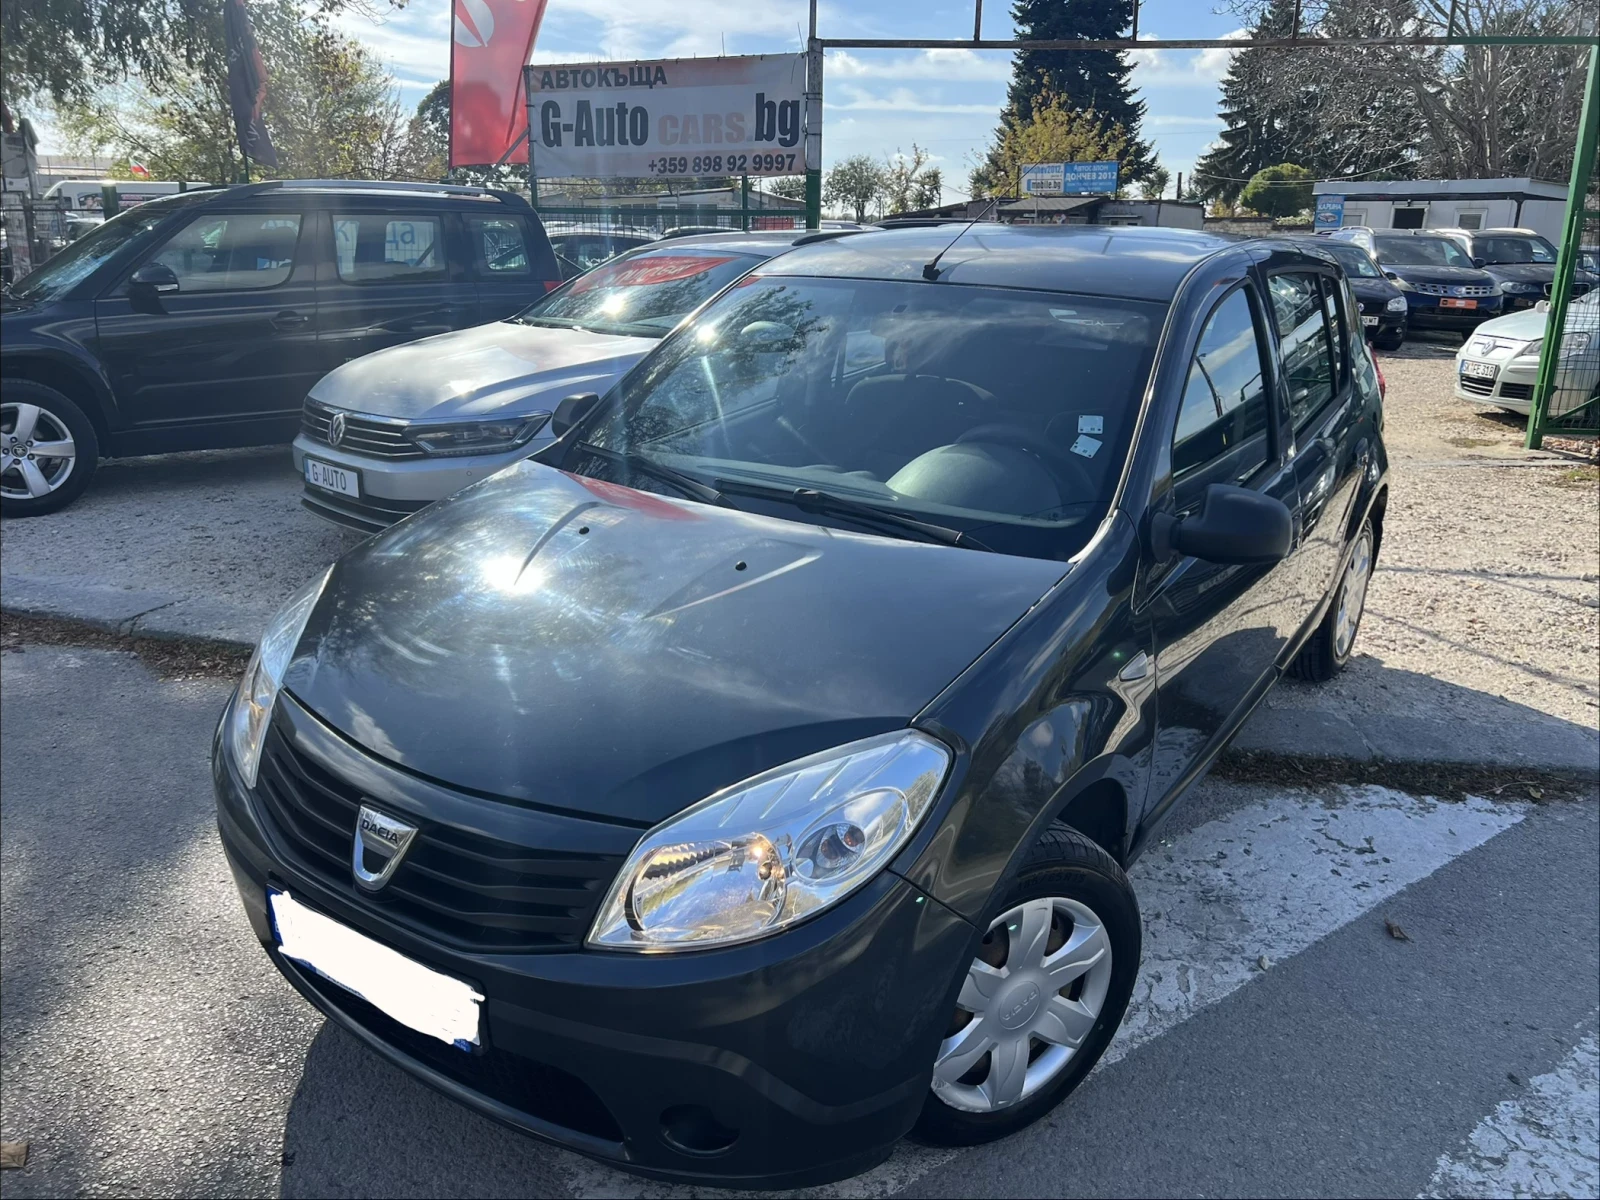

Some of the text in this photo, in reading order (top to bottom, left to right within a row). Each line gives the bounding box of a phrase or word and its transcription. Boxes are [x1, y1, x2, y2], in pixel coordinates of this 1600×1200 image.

[540, 65, 668, 90] АВТОКЪЩА
[540, 99, 649, 148] G-Auto
[649, 154, 796, 174] +359 898 92 9997
[1032, 180, 1061, 190] mobile.bg
[1065, 172, 1096, 182] ДОНЧЕВ
[1098, 171, 1117, 180] 2012
[1481, 365, 1494, 377] 318
[311, 463, 347, 491] G-AUTO
[361, 819, 398, 844] DACIA
